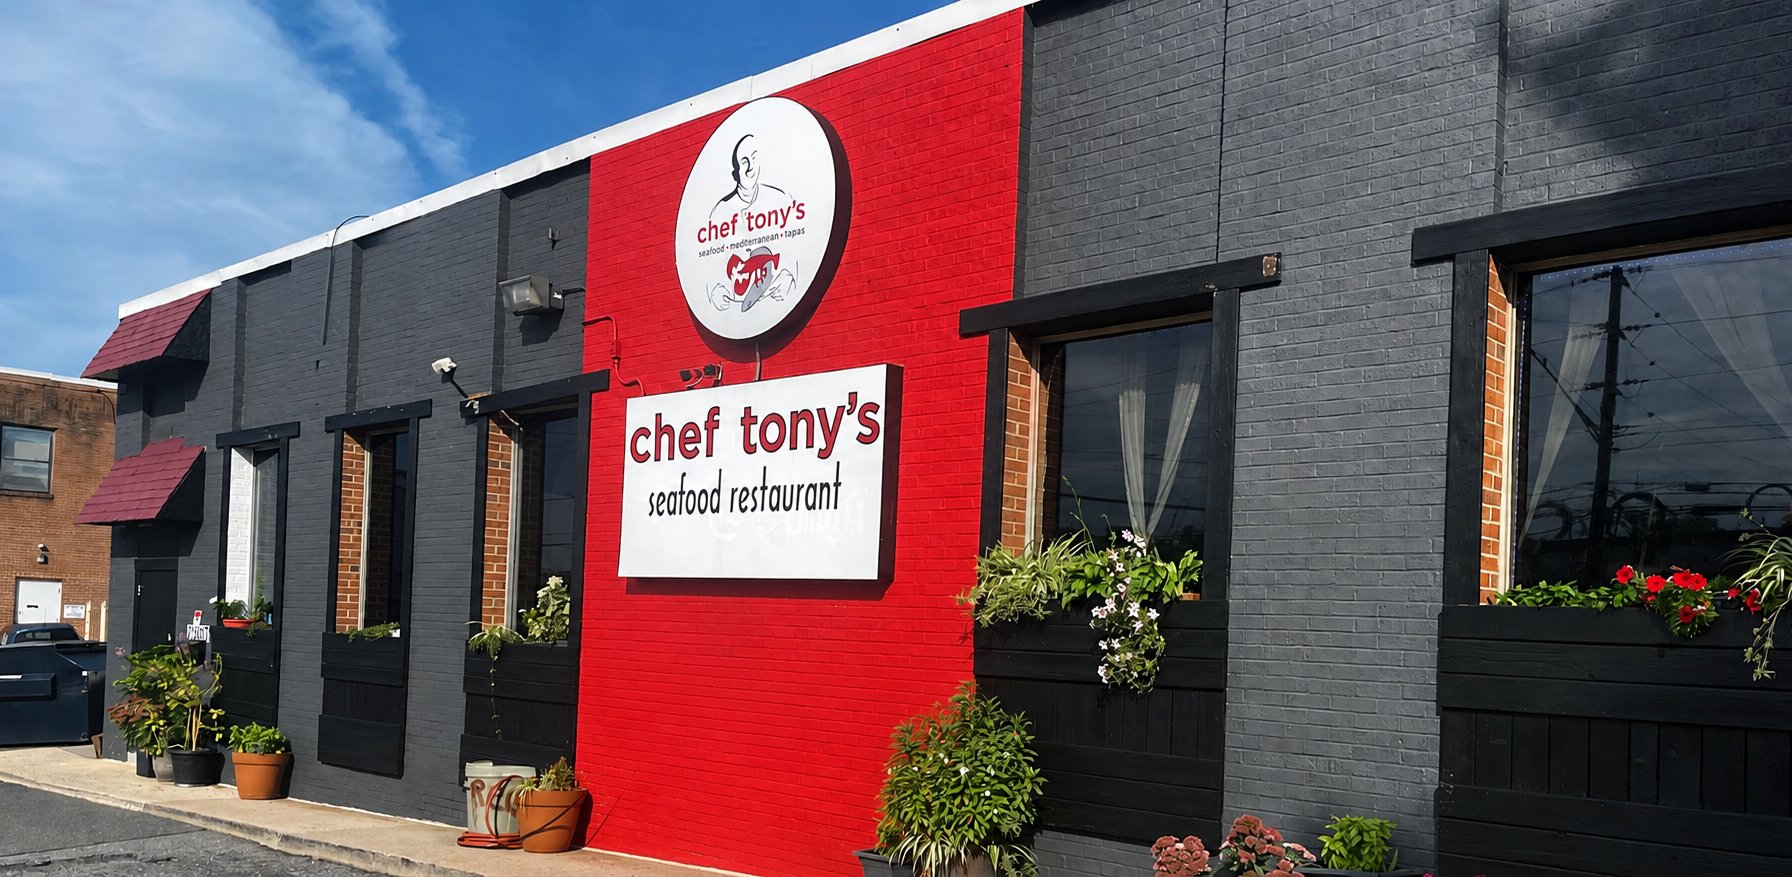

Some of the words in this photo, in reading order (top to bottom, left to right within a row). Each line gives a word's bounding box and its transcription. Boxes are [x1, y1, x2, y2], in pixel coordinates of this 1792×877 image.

[697, 213, 739, 244] chef
[746, 199, 806, 232] tony's
[698, 244, 725, 258] seafood
[730, 233, 779, 250] mediterranean
[784, 227, 805, 239] tapas
[630, 406, 720, 463] chef
[740, 391, 881, 459] tony's
[648, 468, 722, 517] seafood
[729, 461, 842, 513] restaurant
